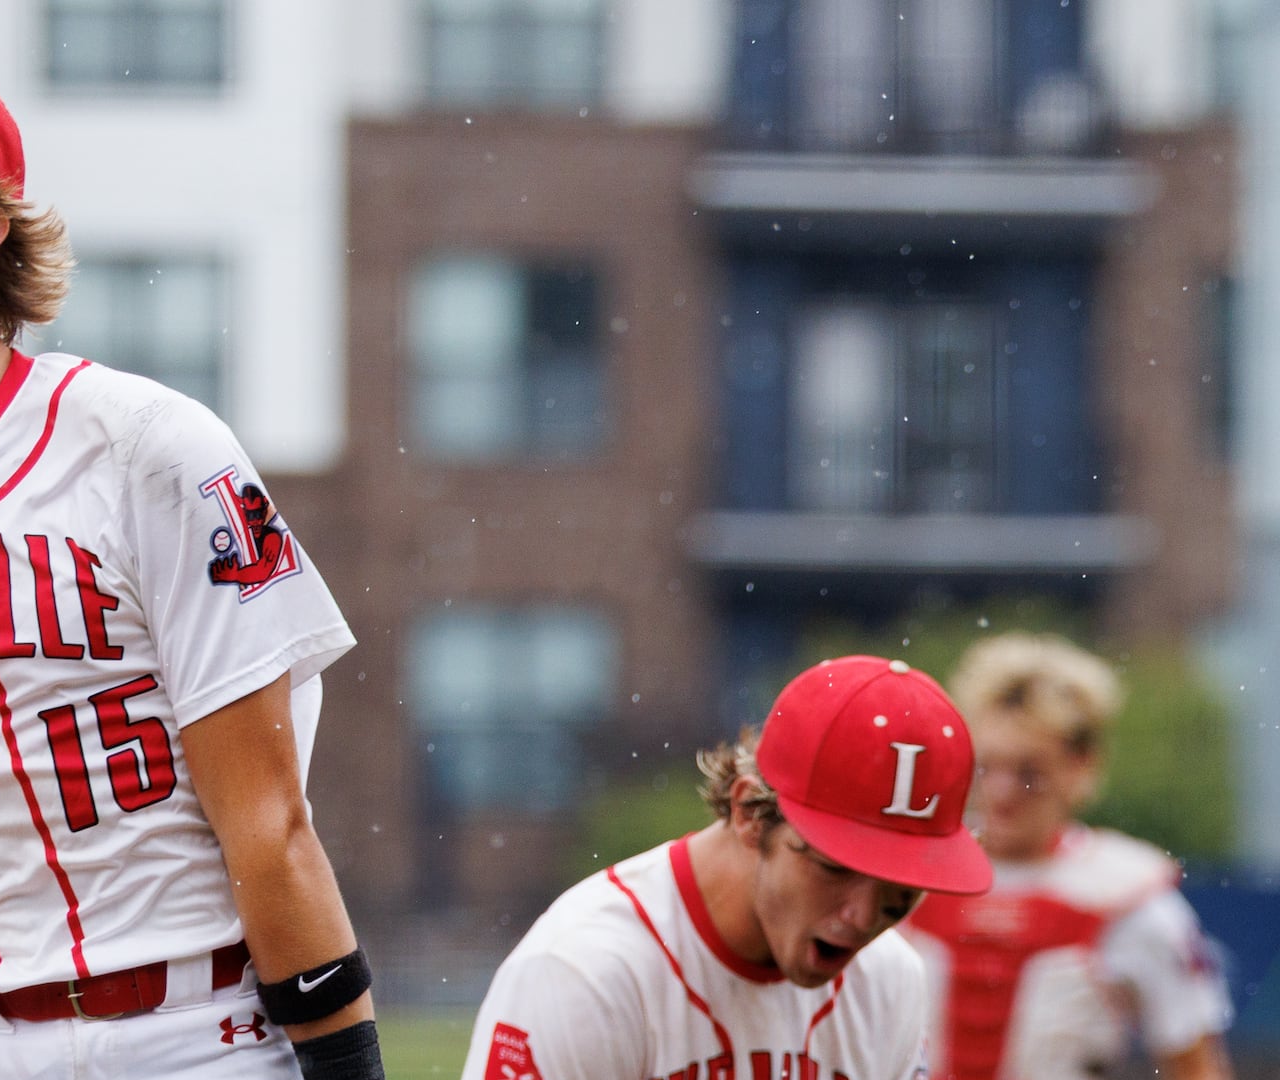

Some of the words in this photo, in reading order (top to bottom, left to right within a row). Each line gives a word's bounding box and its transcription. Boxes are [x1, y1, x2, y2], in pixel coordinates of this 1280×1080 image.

[198, 464, 303, 604] L
[37, 673, 177, 832] 15
[880, 741, 940, 819] L
